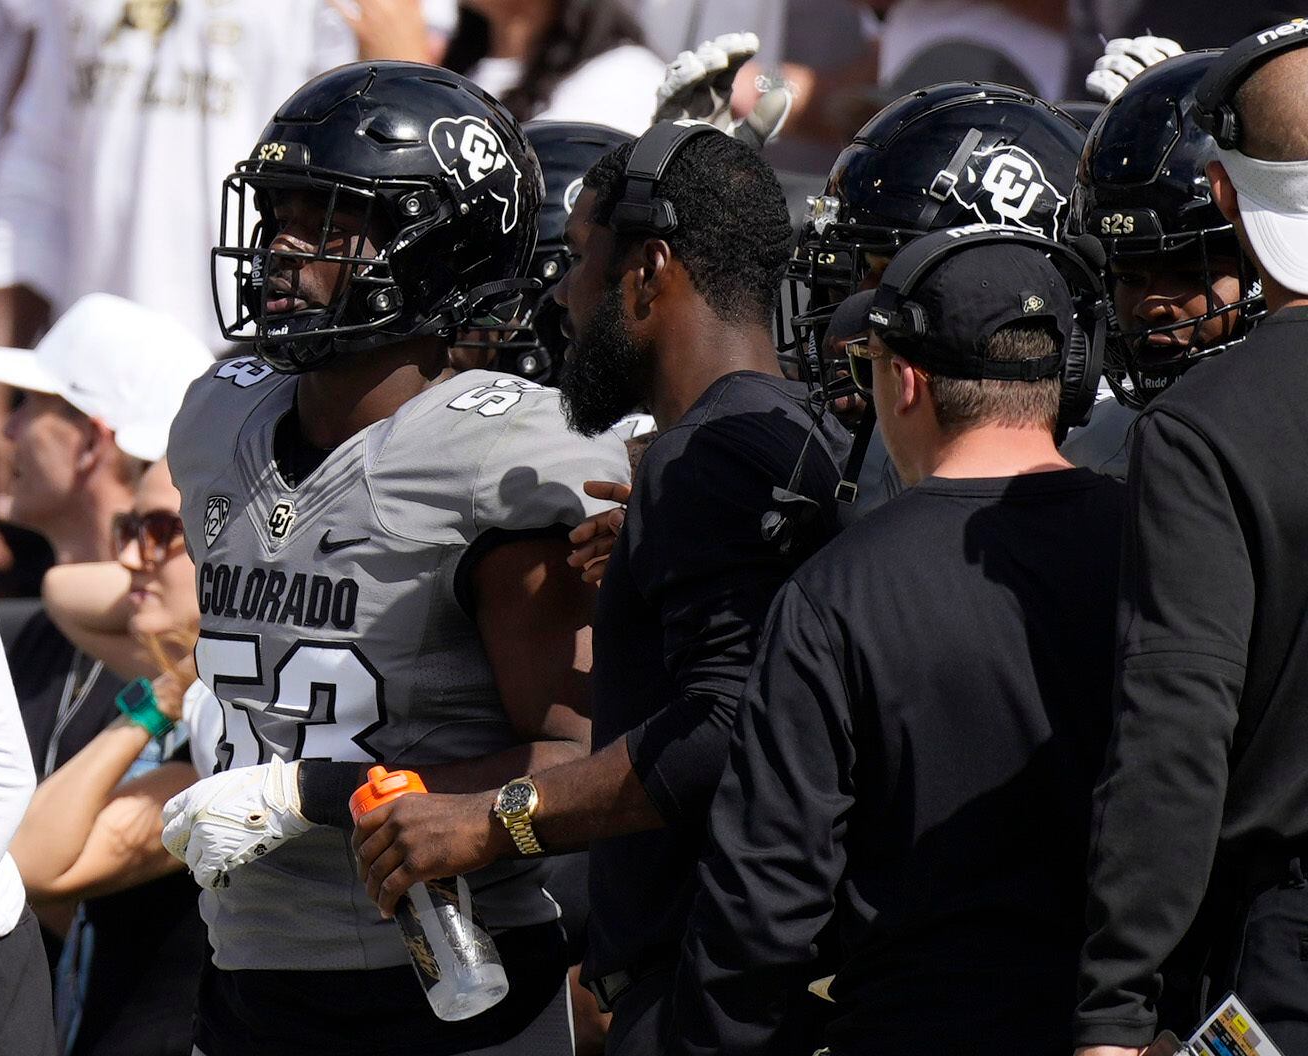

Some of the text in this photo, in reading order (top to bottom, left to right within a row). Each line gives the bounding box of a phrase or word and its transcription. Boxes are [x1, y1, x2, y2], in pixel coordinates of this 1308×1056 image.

[982, 153, 1044, 220] CU
[269, 503, 294, 538] CU
[199, 562, 359, 630] COLORADO
[194, 629, 388, 775] 53
